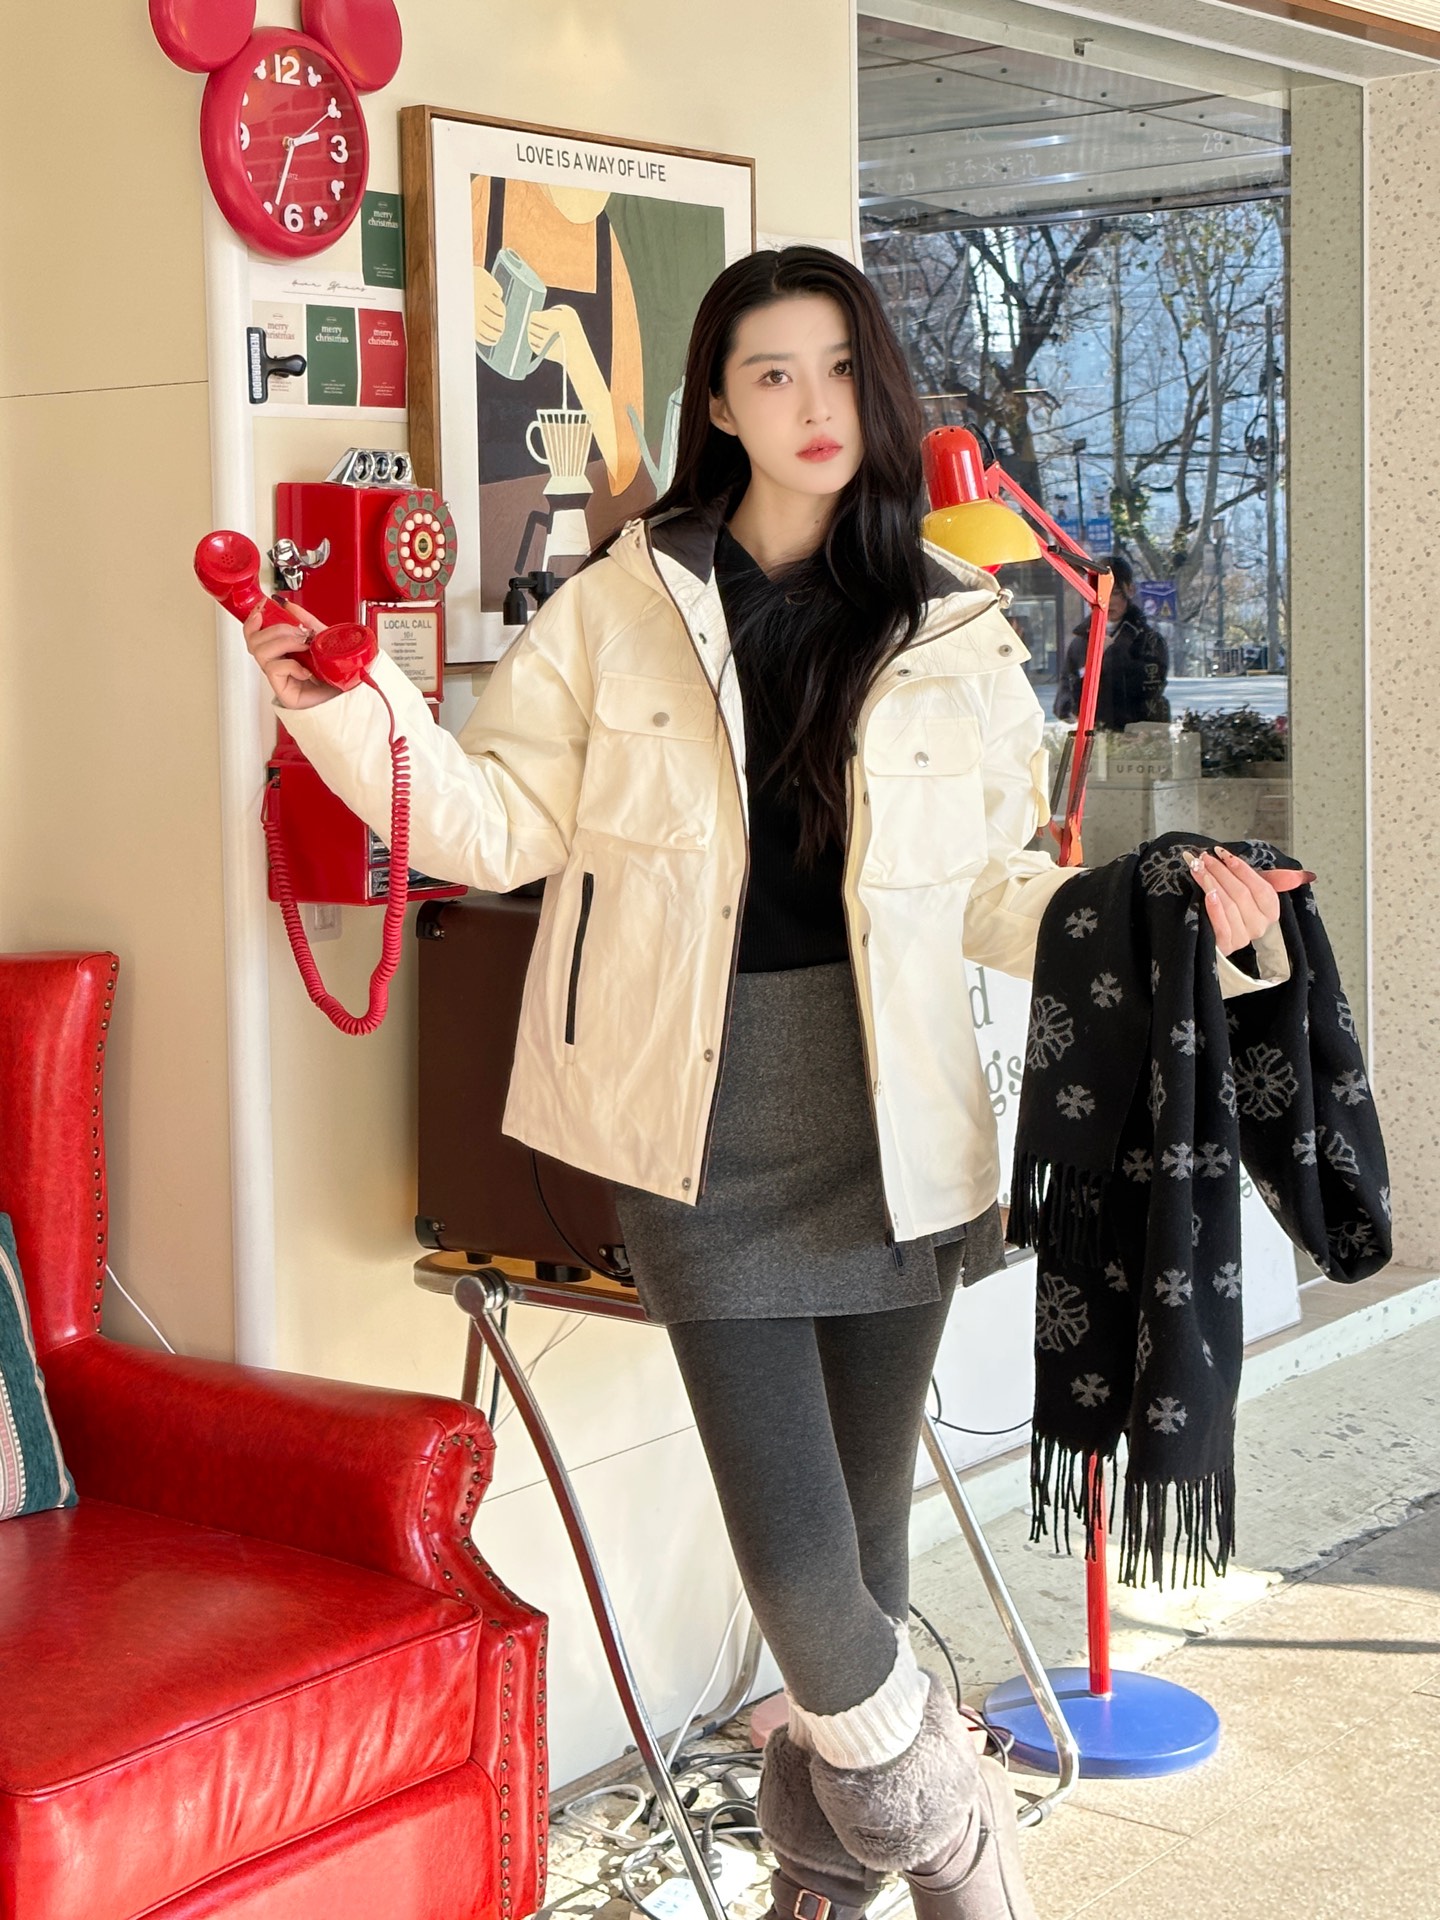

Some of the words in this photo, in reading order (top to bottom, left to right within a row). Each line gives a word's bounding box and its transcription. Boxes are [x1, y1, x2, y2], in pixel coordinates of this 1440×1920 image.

[274, 54, 300, 85] 12
[330, 135, 349, 164] 3
[516, 143, 554, 166] LOVE
[557, 150, 570, 168] IS
[573, 152, 583, 170] A
[584, 153, 615, 175] WAY
[617, 158, 635, 177] OF
[637, 161, 666, 182] LIFE
[283, 203, 304, 232] 6
[373, 210, 393, 222] merry
[368, 217, 399, 229] christmas
[267, 321, 289, 334] merry
[321, 325, 343, 336] merry
[373, 328, 393, 339] merry
[265, 330, 295, 340] hristmas
[315, 334, 349, 344] christmas
[368, 336, 400, 347] christmas
[384, 620, 410, 630] LOCAL
[412, 620, 432, 629] CALL
